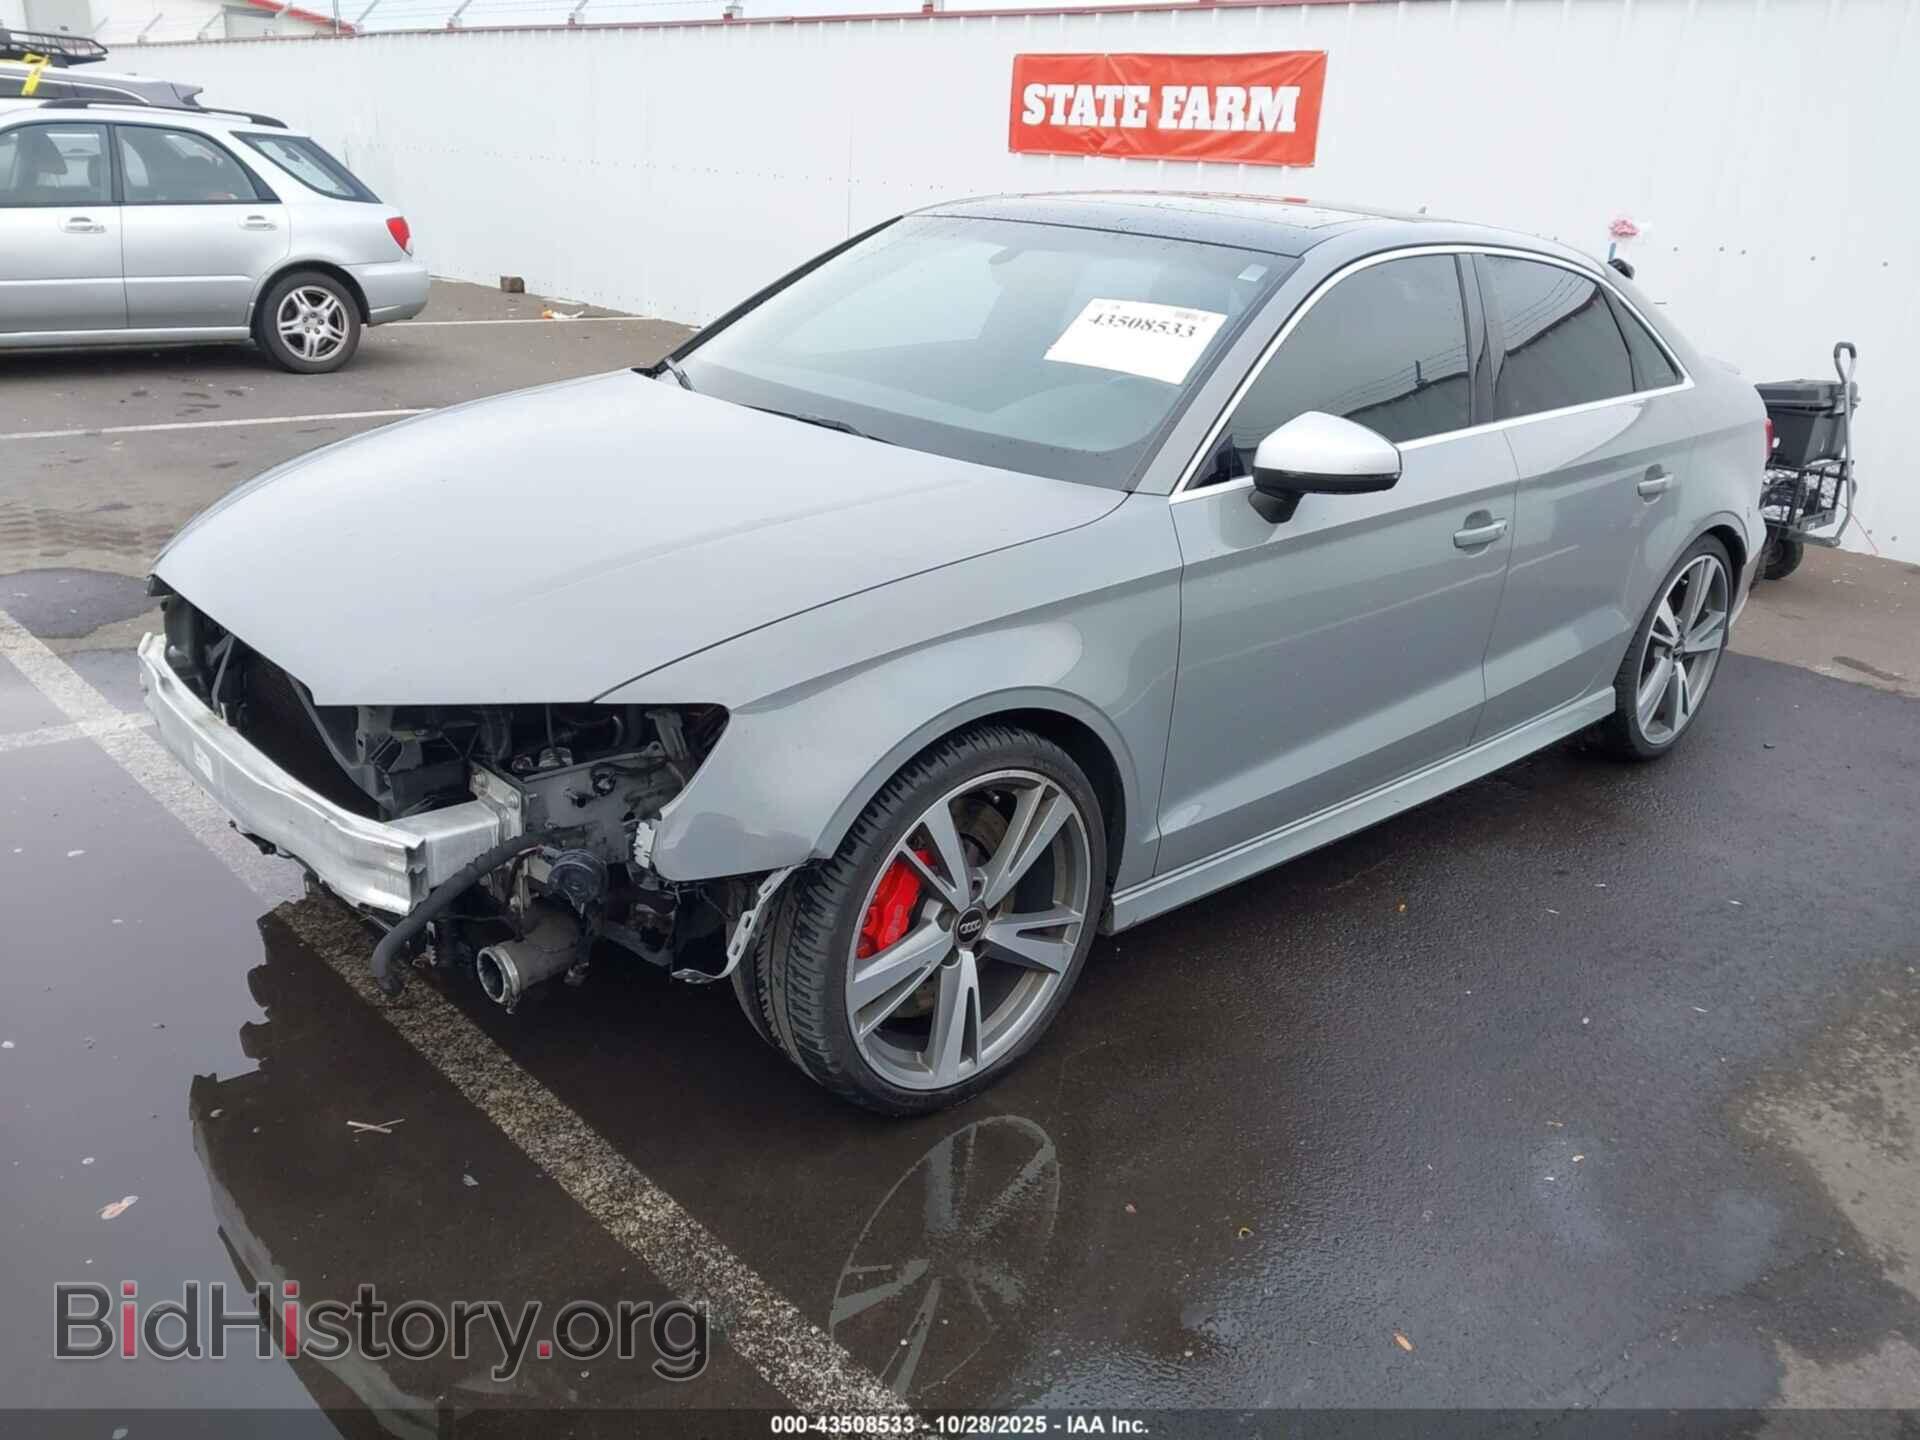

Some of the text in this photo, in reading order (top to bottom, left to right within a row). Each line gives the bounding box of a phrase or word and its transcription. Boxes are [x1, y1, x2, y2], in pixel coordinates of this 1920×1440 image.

[1022, 83, 1300, 131] STATE FARM
[1088, 312, 1197, 338] 43508533
